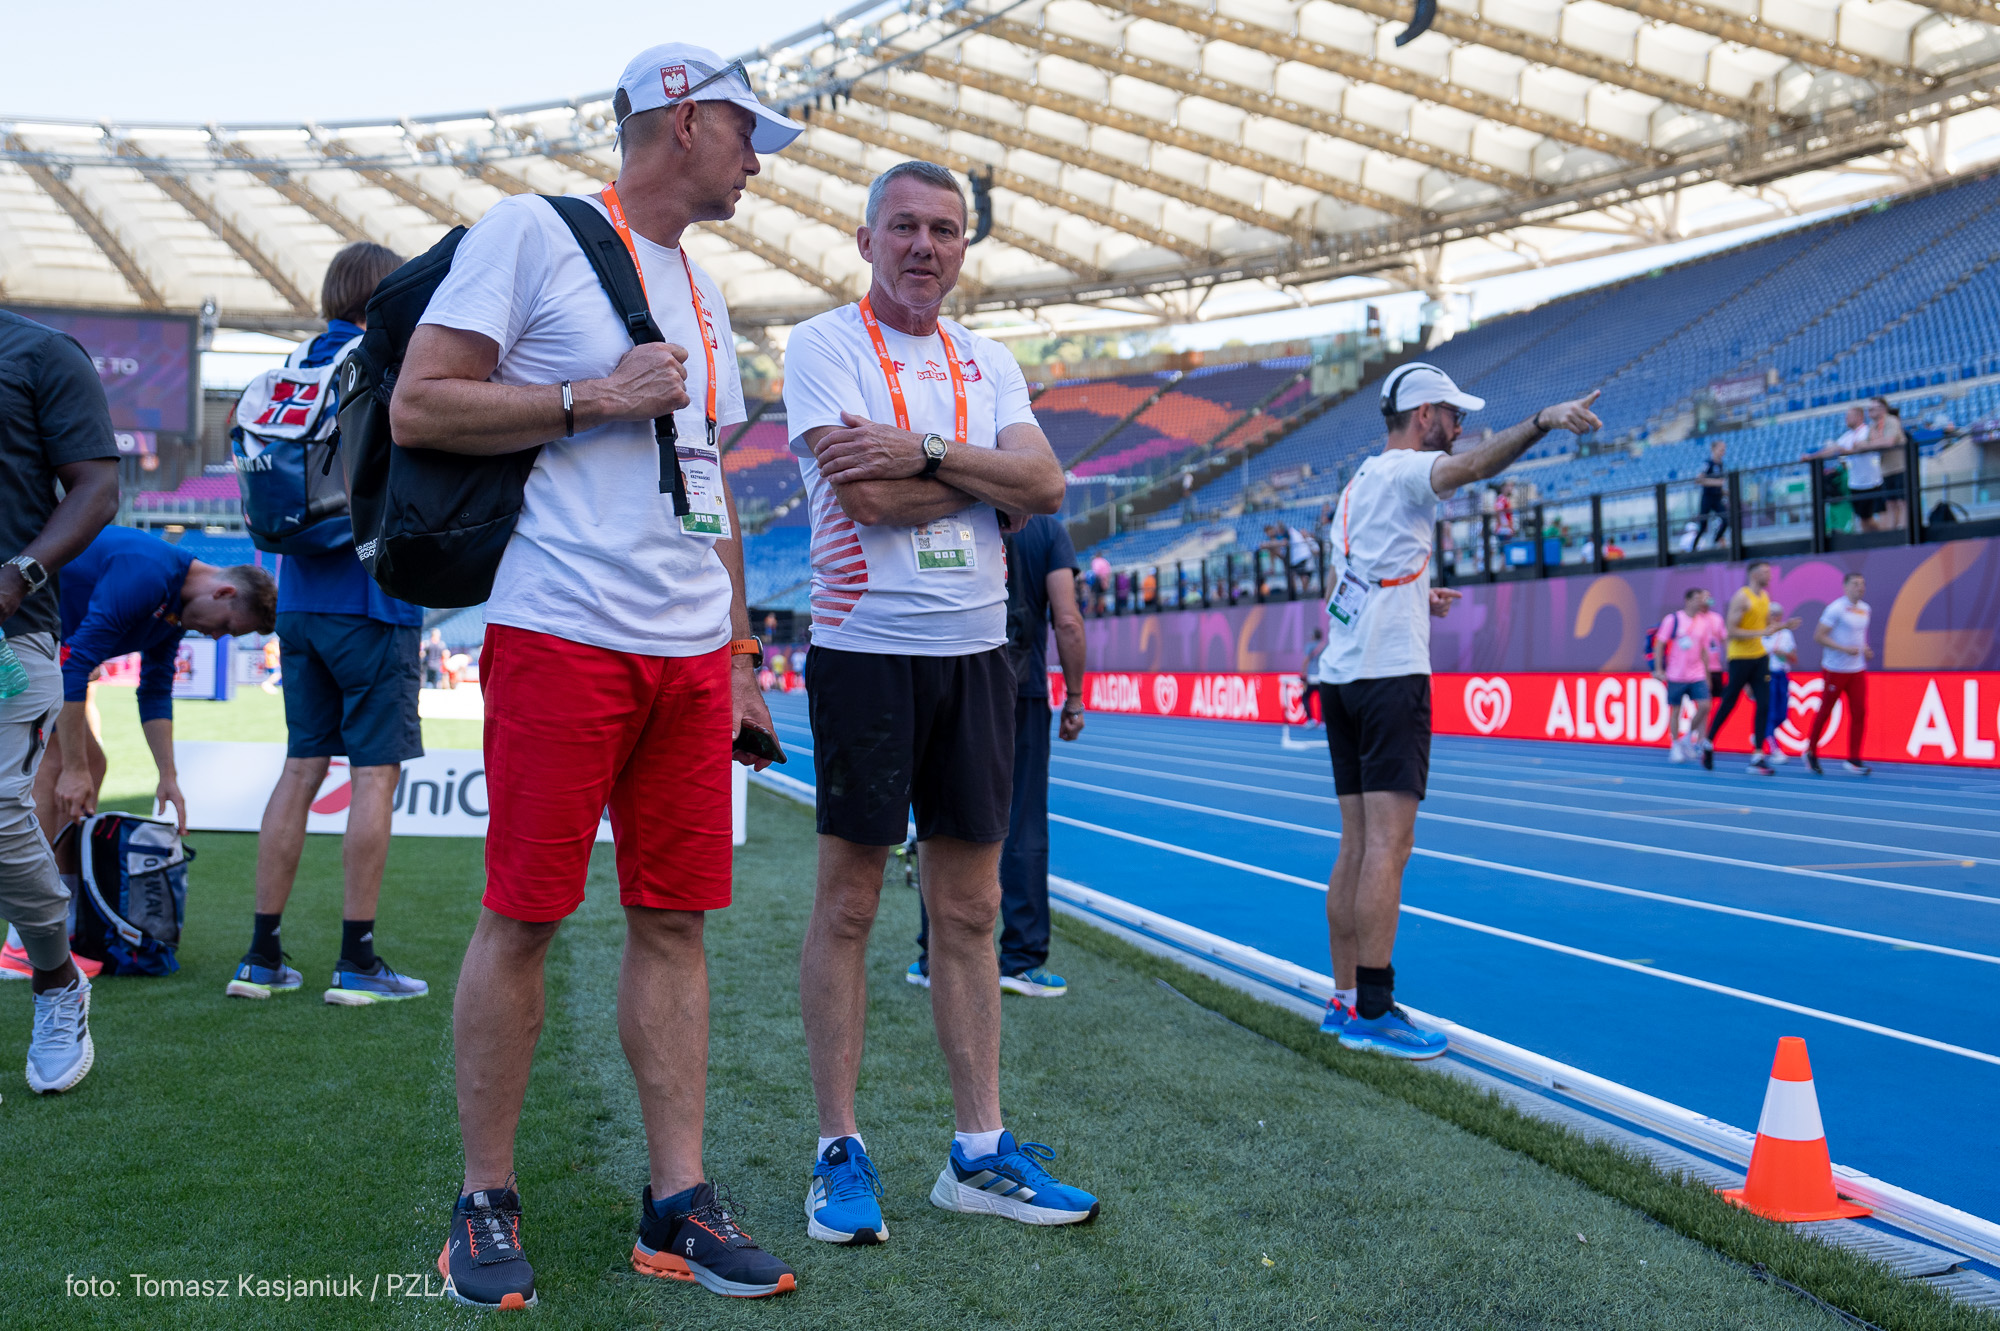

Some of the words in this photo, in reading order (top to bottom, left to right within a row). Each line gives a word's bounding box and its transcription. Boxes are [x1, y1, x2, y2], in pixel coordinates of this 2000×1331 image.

[662, 65, 685, 73] POLSKA
[1090, 674, 1142, 712] ALGIDA
[1189, 675, 1260, 720] ALGIDA
[1906, 678, 2000, 761] AL
